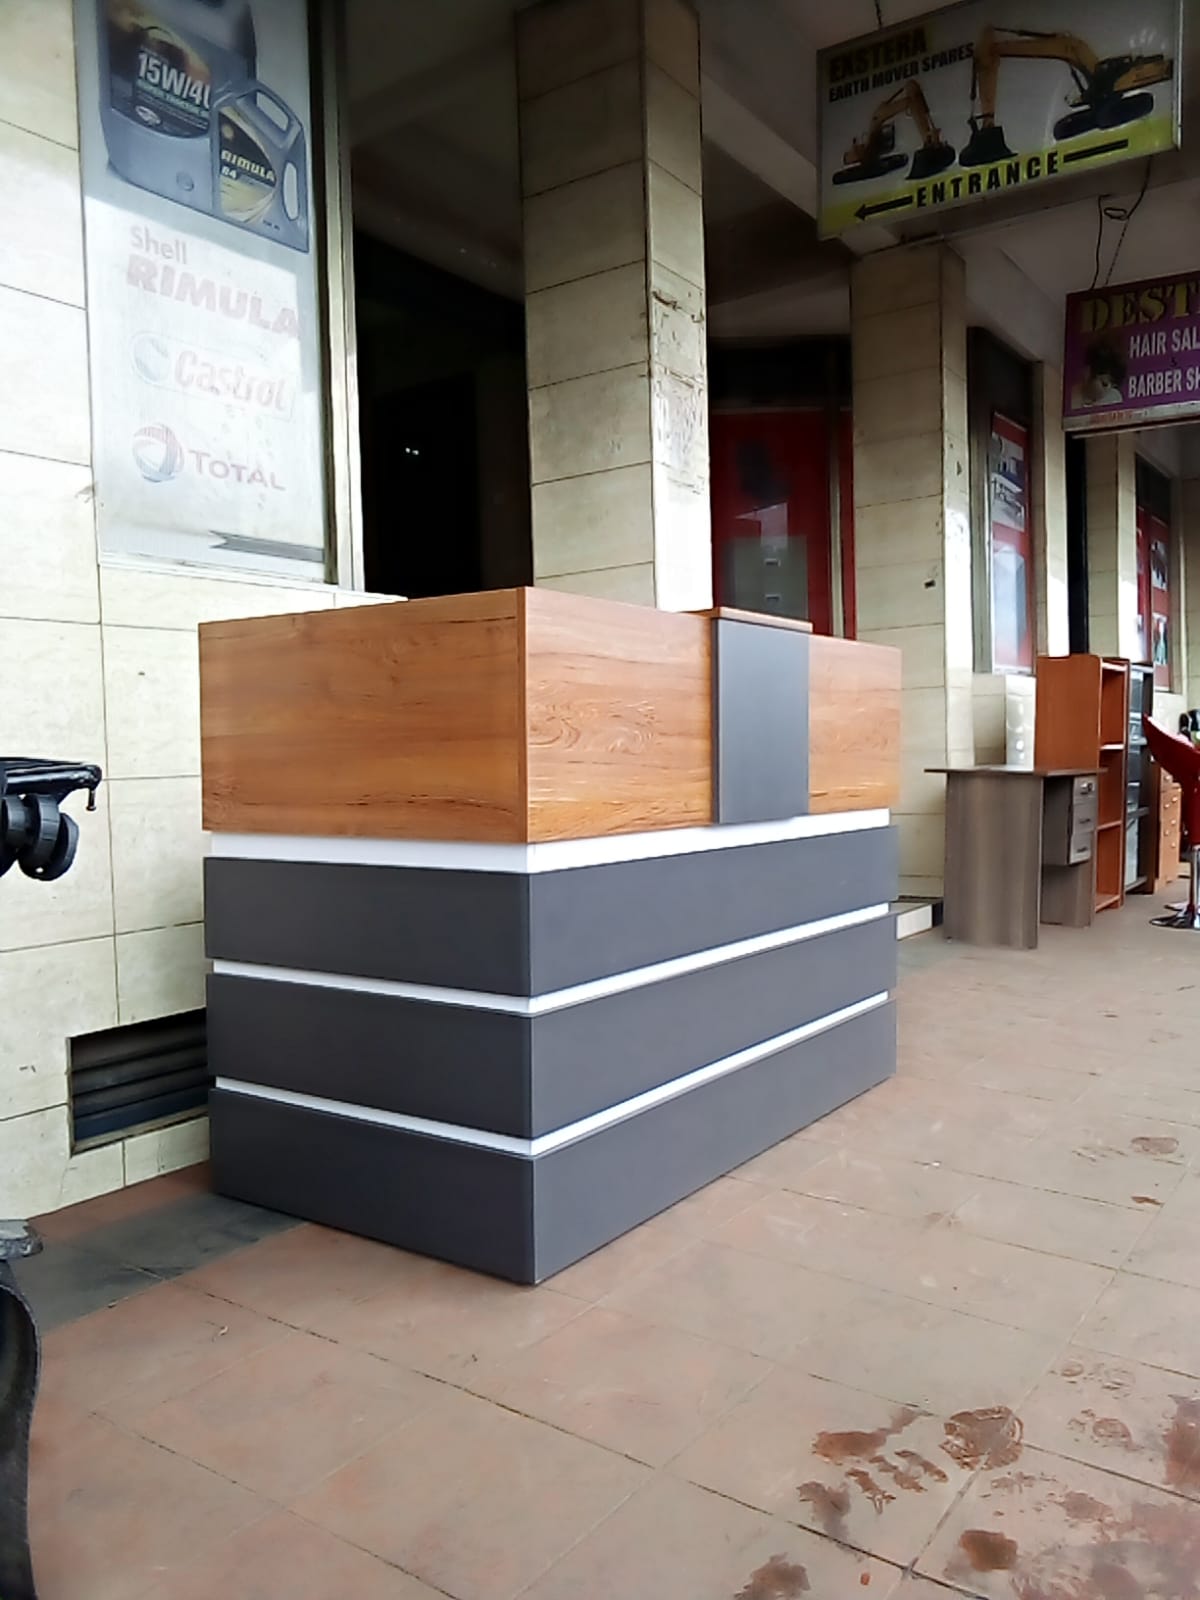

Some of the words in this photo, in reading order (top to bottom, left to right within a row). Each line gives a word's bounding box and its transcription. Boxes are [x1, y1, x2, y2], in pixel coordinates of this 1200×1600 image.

[828, 77, 870, 102] EARTH
[872, 60, 919, 88] MOVER
[921, 43, 975, 72] SPARES
[916, 151, 1059, 208] ENTRANCE
[130, 225, 187, 265] Shell
[127, 254, 300, 340] RIMULA
[1080, 282, 1200, 334] DEST
[1129, 331, 1167, 359] HAIR
[1171, 326, 1200, 352] SAL
[174, 350, 288, 412] Castrol
[1128, 368, 1182, 399] BARBER
[188, 448, 287, 491] TOTAL
